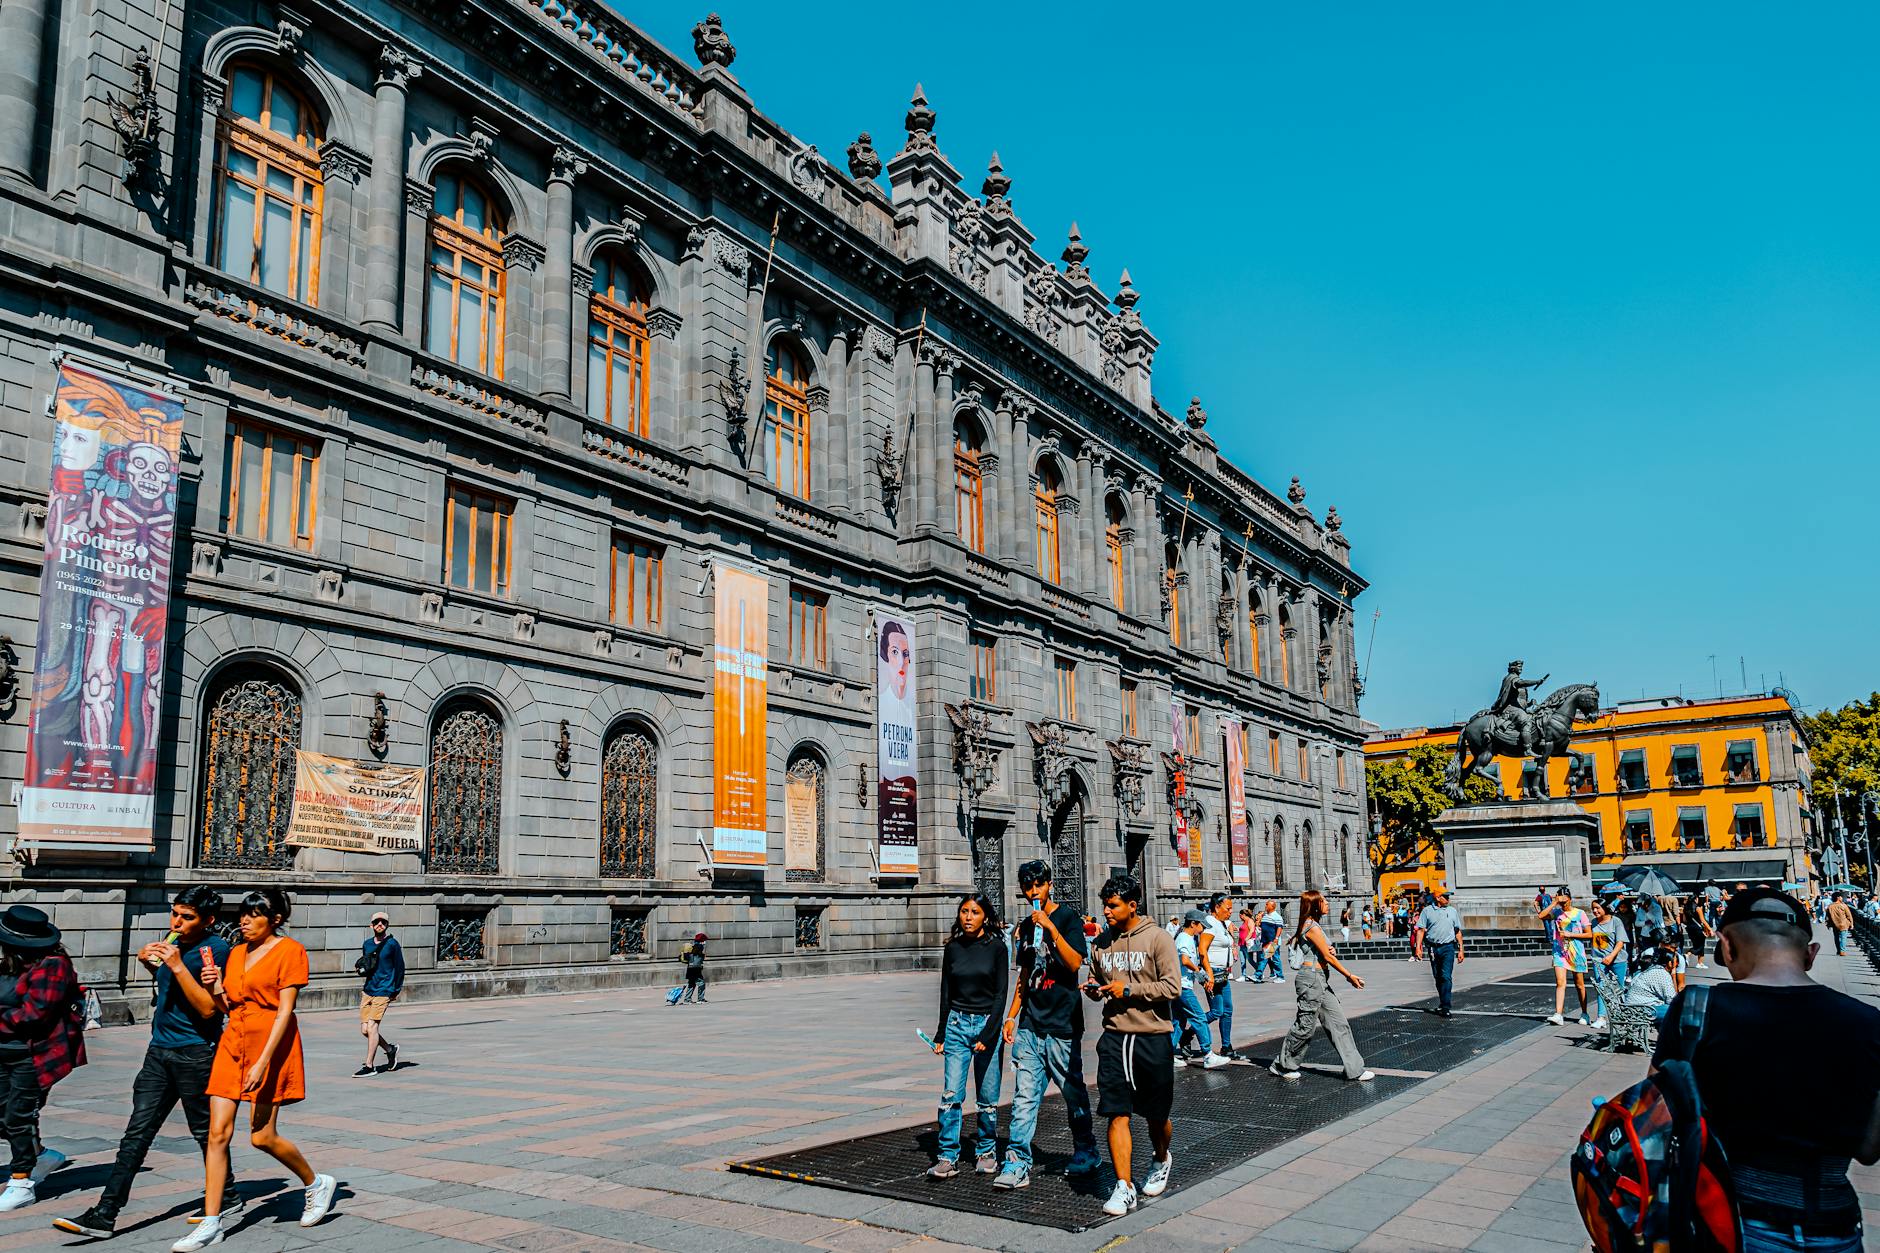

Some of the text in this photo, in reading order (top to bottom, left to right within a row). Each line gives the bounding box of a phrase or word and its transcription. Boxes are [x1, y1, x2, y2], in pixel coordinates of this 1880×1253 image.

[62, 524, 149, 560] Rodrigo
[58, 546, 157, 582] Pimentel
[55, 580, 145, 606] Transmutaciones
[60, 622, 73, 630] 29
[74, 624, 86, 633] de
[883, 722, 913, 743] PETRONA
[888, 741, 909, 760] VIERA
[348, 785, 416, 800] SATINBAL
[51, 801, 141, 815] CULTURA INBAL
[298, 813, 323, 822] NUESTROS
[1113, 951, 1147, 969] REASON
